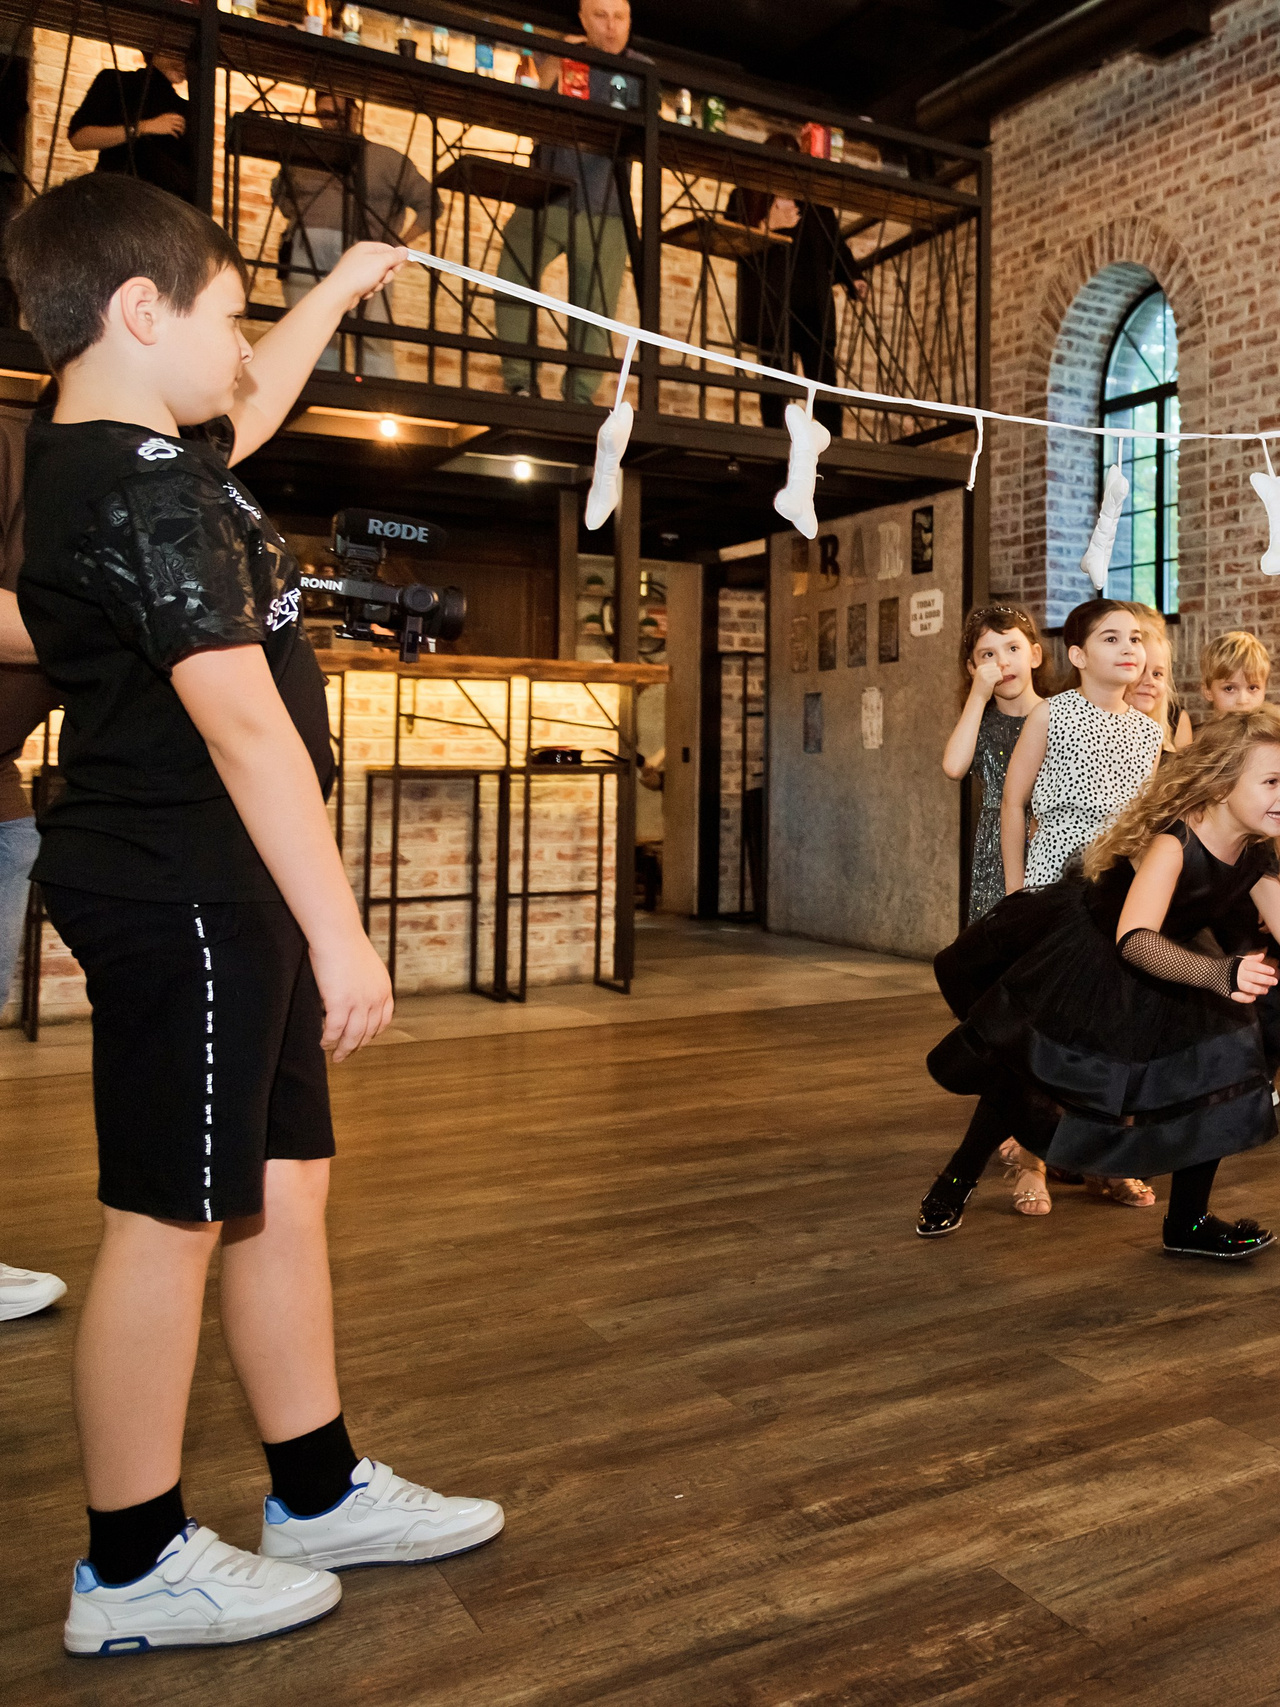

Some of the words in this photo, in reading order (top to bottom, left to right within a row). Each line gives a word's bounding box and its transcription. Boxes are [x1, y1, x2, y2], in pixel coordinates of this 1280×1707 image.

[367, 518, 430, 543] RØDE
[300, 576, 343, 592] RONIN
[916, 599, 935, 609] TODAY
[920, 622, 932, 631] DAY
